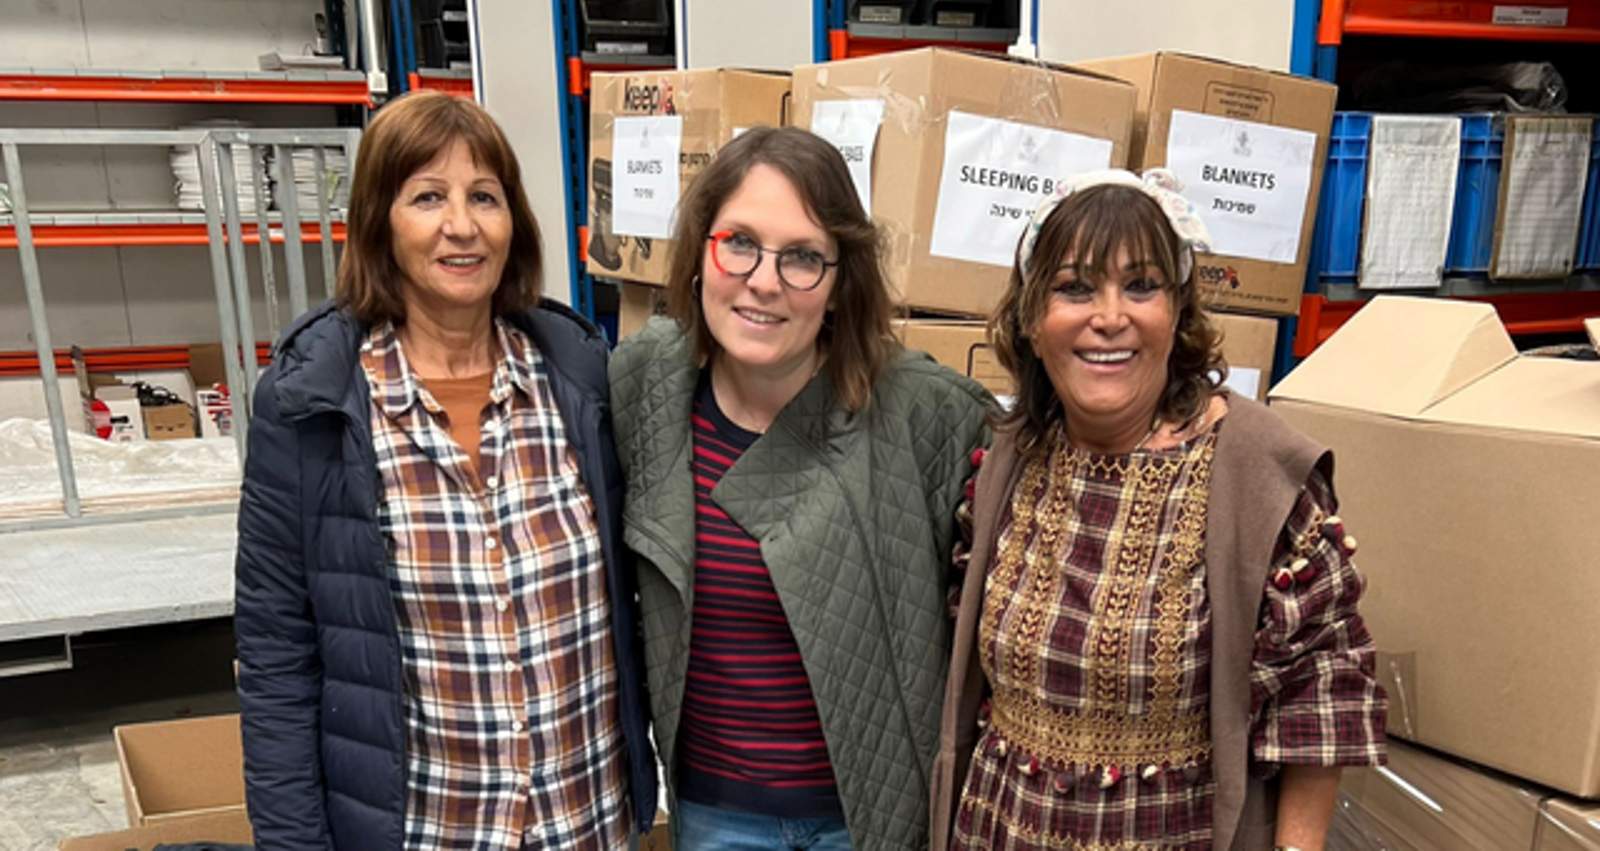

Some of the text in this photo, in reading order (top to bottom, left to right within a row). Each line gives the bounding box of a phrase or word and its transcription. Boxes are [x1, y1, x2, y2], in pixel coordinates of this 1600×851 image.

[959, 165, 1039, 194] SLEEPING
[1201, 165, 1276, 190] BLANKETS
[1211, 197, 1256, 215] שמיכות
